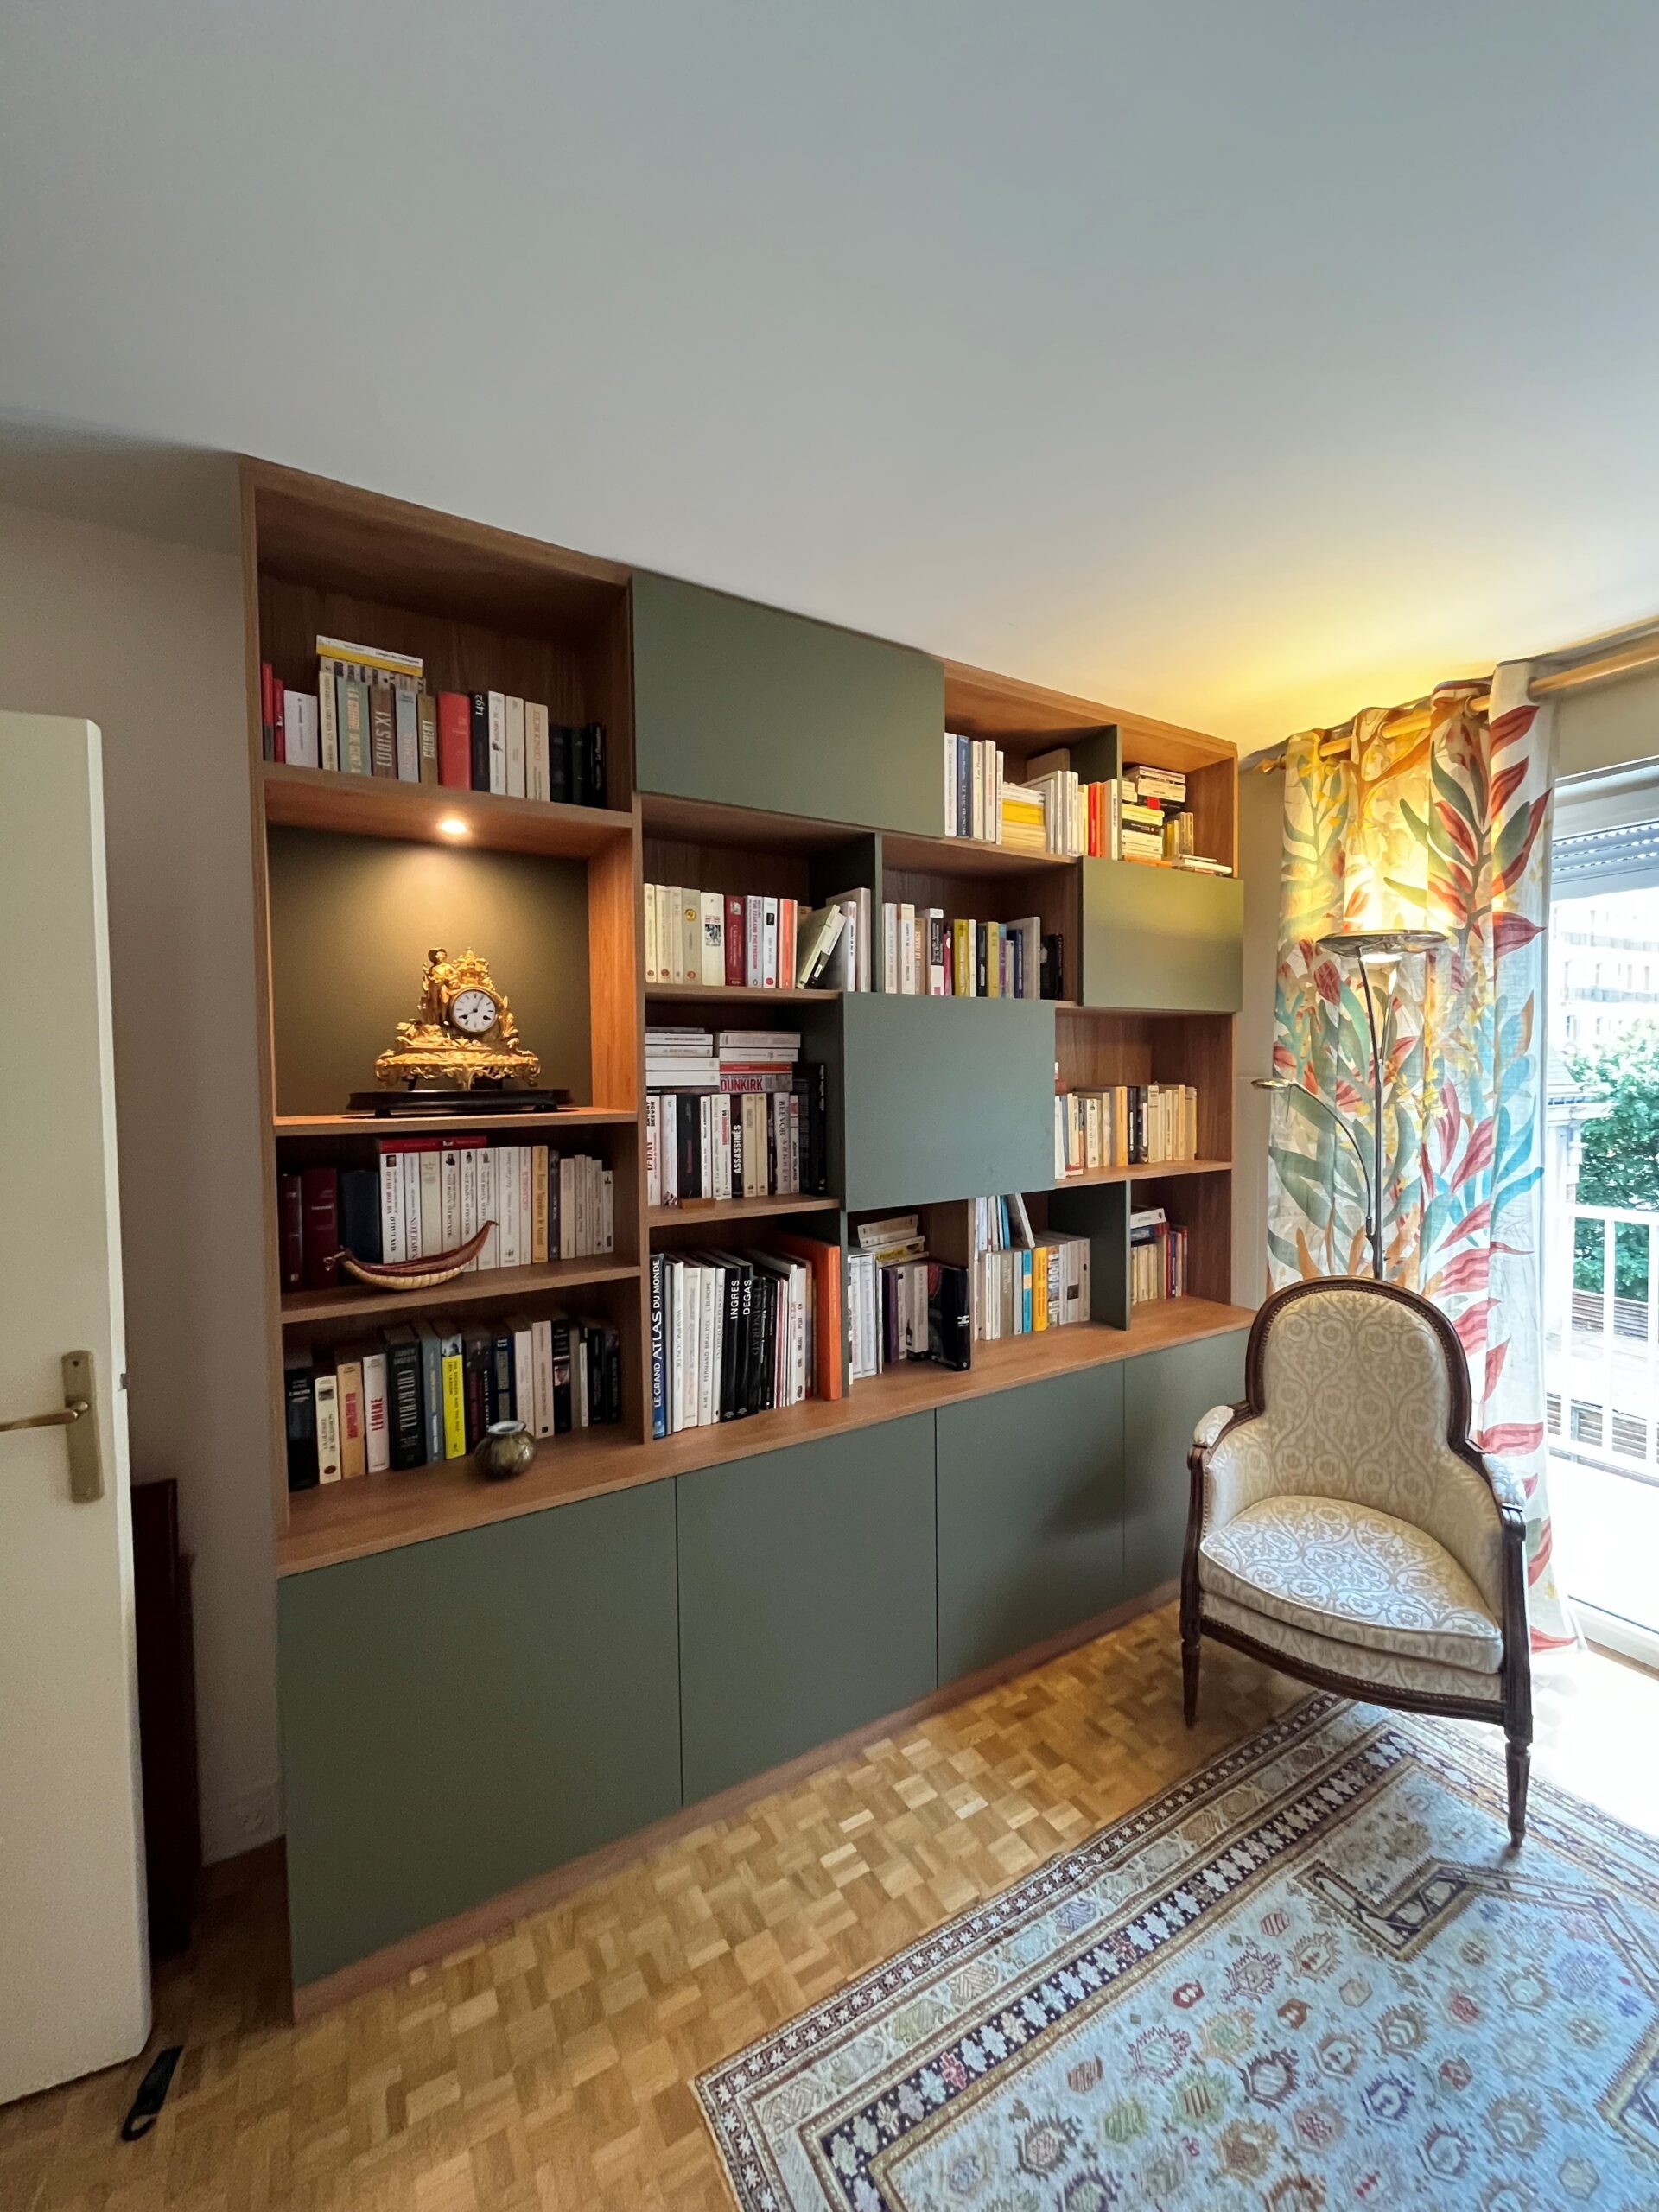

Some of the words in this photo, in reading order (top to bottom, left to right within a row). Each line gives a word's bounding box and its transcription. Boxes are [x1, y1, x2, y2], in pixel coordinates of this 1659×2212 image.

[376, 710, 391, 726] XI
[474, 694, 485, 716] 1492
[376, 728, 392, 767] LOUIS
[422, 719, 435, 759] COLBERT
[720, 1078, 763, 1092] DUNKIRK
[779, 1101, 787, 1135] BEEVOR
[732, 1124, 741, 1173] ASSASSINÉS
[653, 1295, 661, 1309] DU
[729, 1280, 740, 1319] INGRES
[742, 1279, 752, 1316] DEGAS
[652, 1310, 663, 1360] ATLAS
[752, 1287, 762, 1356] LENINGRAD
[371, 1398, 385, 1431] LÉNINE
[397, 1370, 417, 1432] CHURCHILL
[654, 1395, 662, 1408] LE
